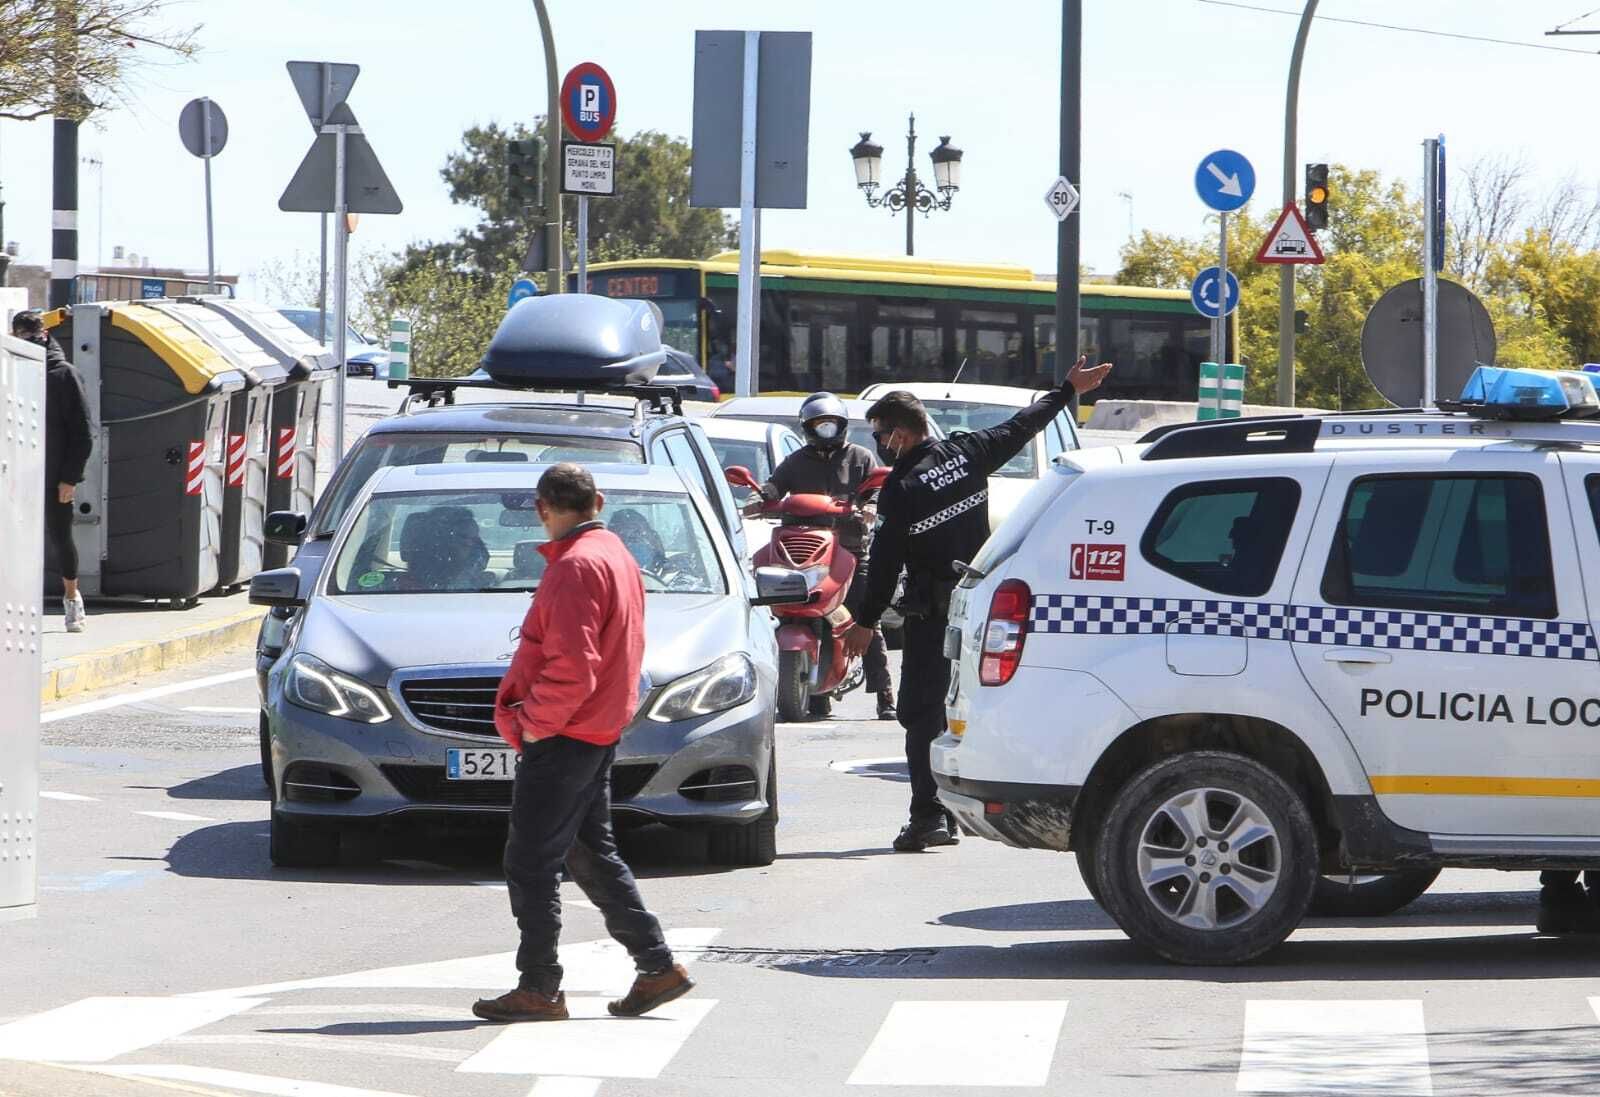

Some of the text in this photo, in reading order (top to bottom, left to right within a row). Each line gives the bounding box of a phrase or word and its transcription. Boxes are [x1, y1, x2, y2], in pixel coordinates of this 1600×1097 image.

[585, 89, 596, 108] P
[580, 111, 600, 122] BUS
[590, 159, 599, 168] DEL
[1054, 191, 1068, 205] 50
[608, 277, 657, 297] CENTRO
[1331, 423, 1485, 435] DUSTER
[919, 454, 968, 484] POLICIA
[930, 467, 968, 491] LOCAL
[1084, 519, 1115, 535] T-9
[1087, 550, 1122, 565] 112
[1360, 688, 1600, 727] POLICIA LOC
